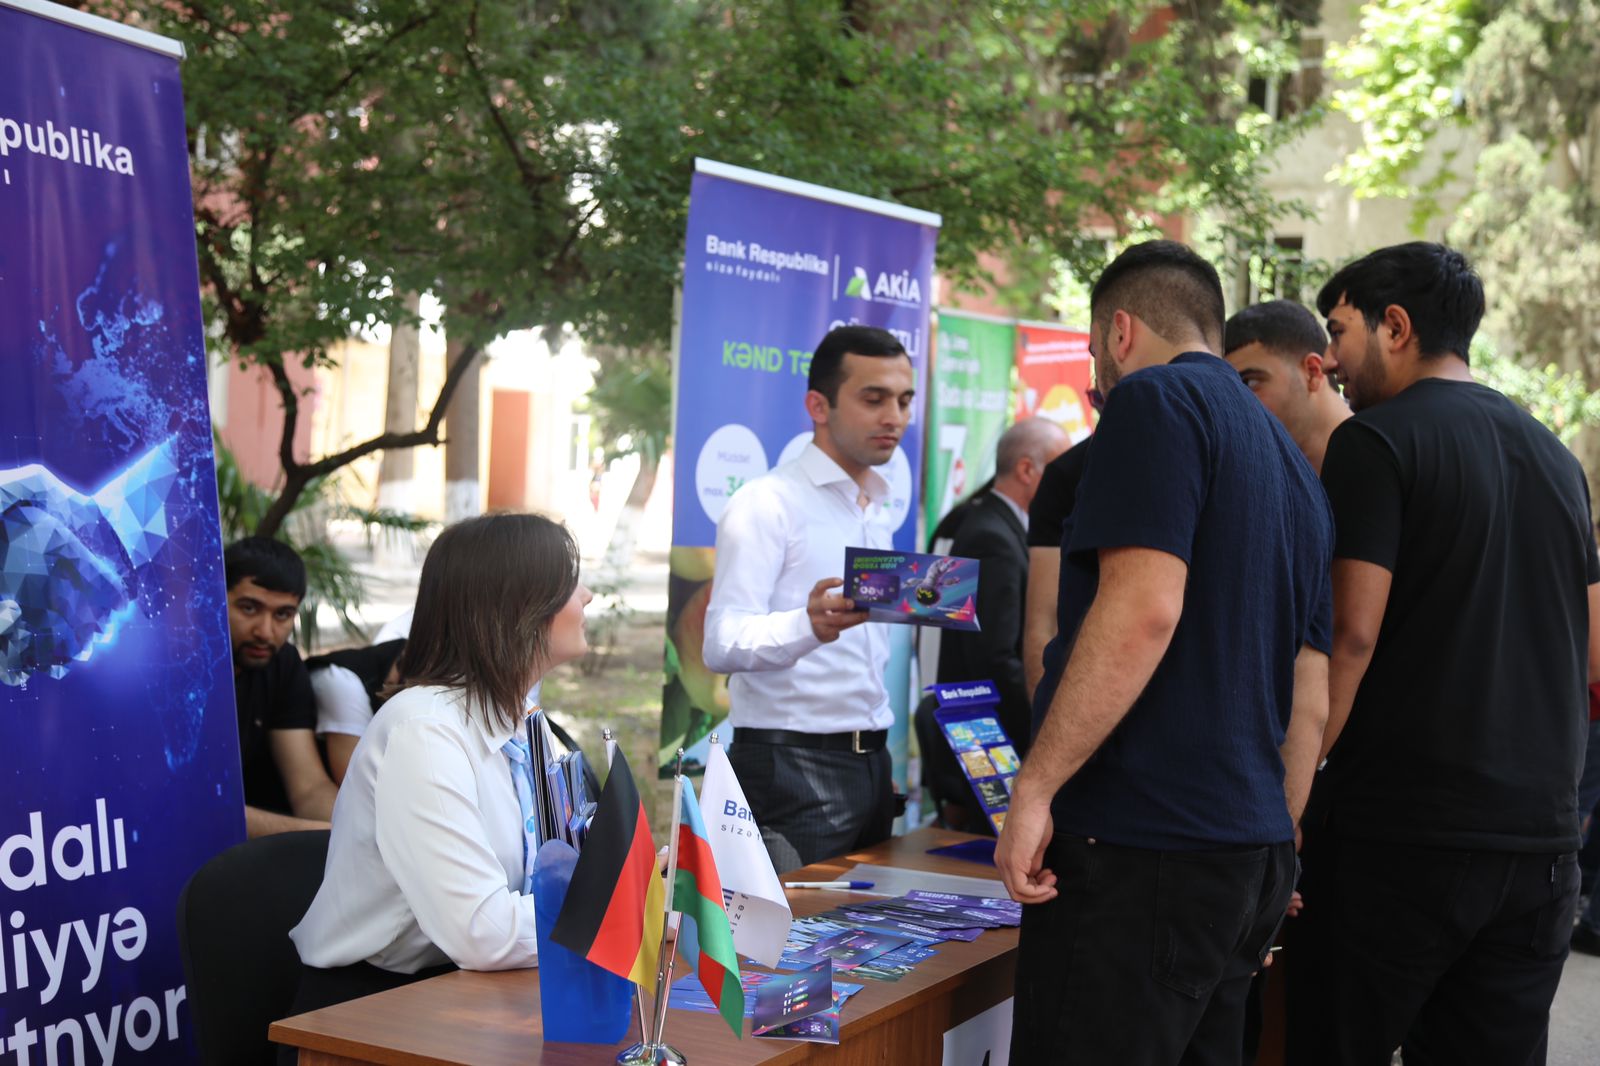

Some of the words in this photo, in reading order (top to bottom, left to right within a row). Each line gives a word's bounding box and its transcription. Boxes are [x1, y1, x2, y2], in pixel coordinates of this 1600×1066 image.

[0, 117, 135, 176] publika
[706, 234, 746, 260] Bank
[749, 242, 829, 276] Respublika
[722, 340, 784, 374] KƏND
